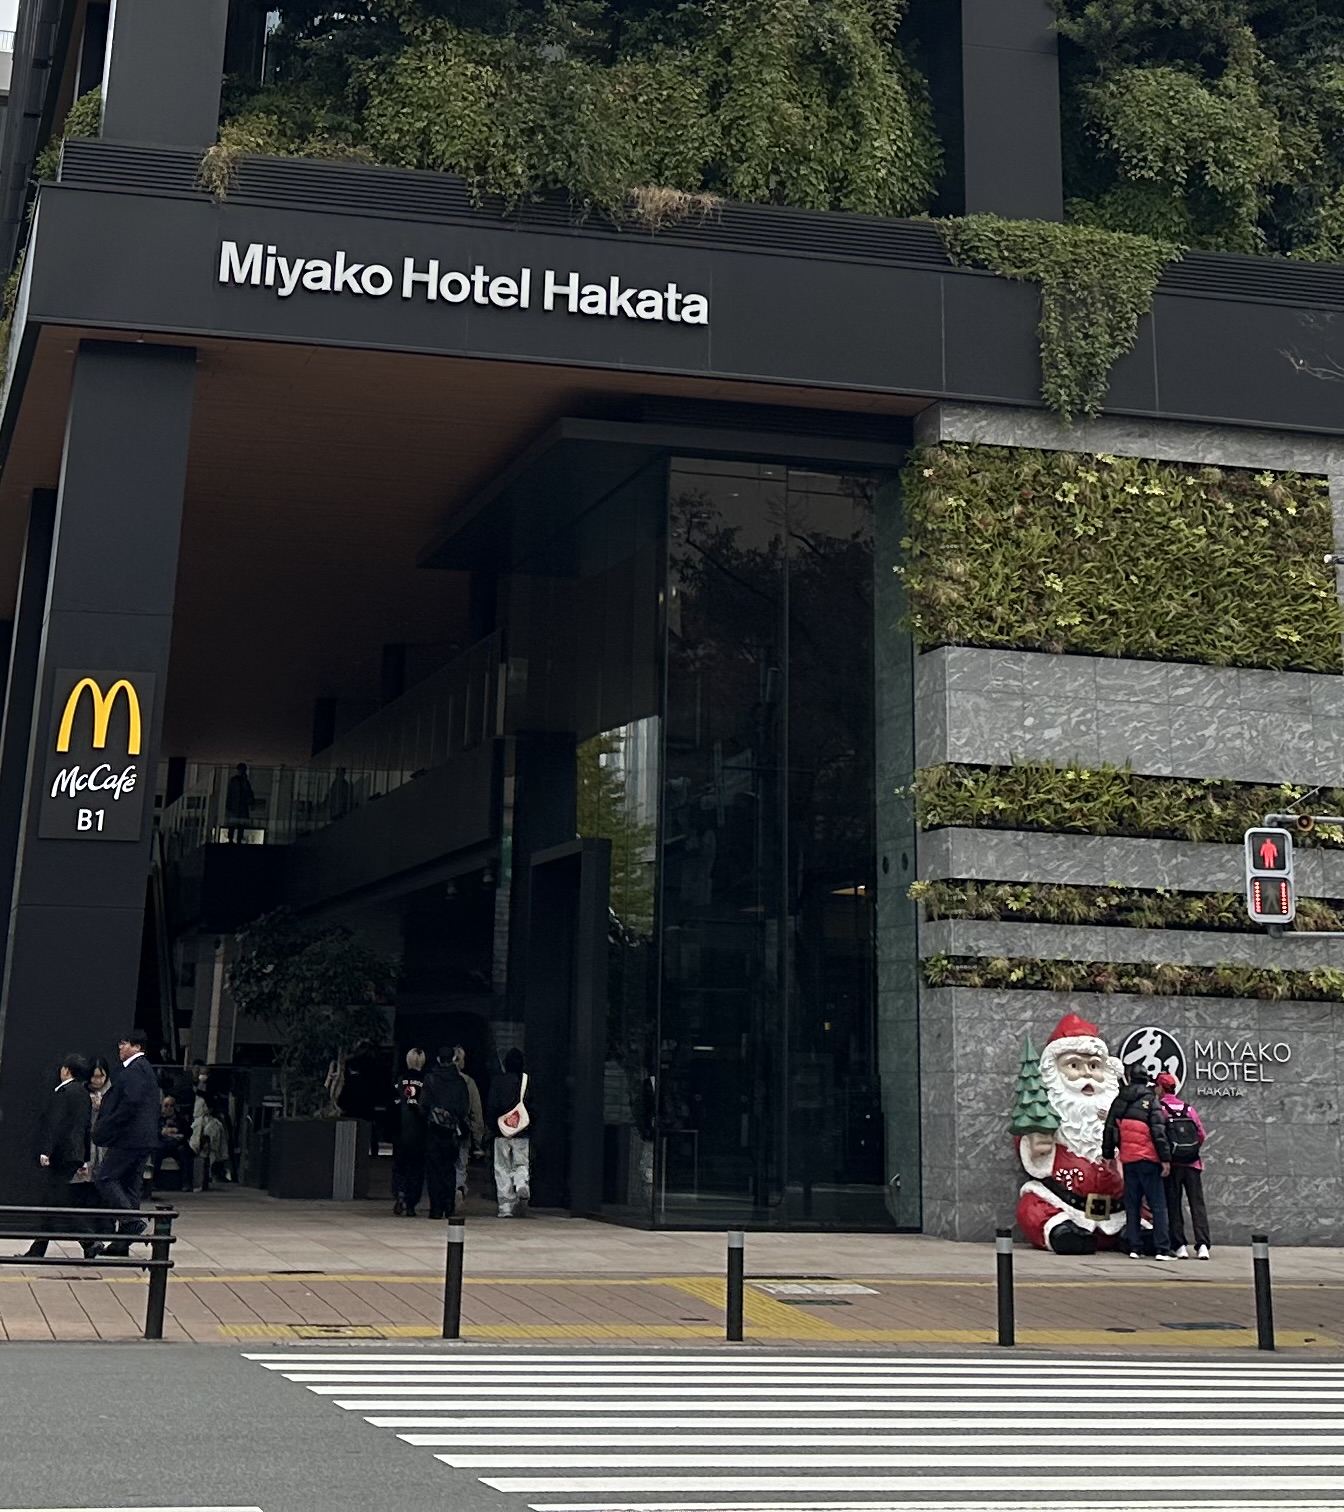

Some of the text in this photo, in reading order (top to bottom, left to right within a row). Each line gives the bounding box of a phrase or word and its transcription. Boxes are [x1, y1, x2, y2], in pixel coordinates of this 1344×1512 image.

[218, 240, 709, 326] Miyako Hotel Hakata
[50, 763, 138, 800] McCafé
[76, 808, 106, 832] B1
[1194, 1039, 1292, 1064] MIYAKO
[1195, 1061, 1275, 1083] HOTEL
[1197, 1086, 1244, 1097] HAKATA
